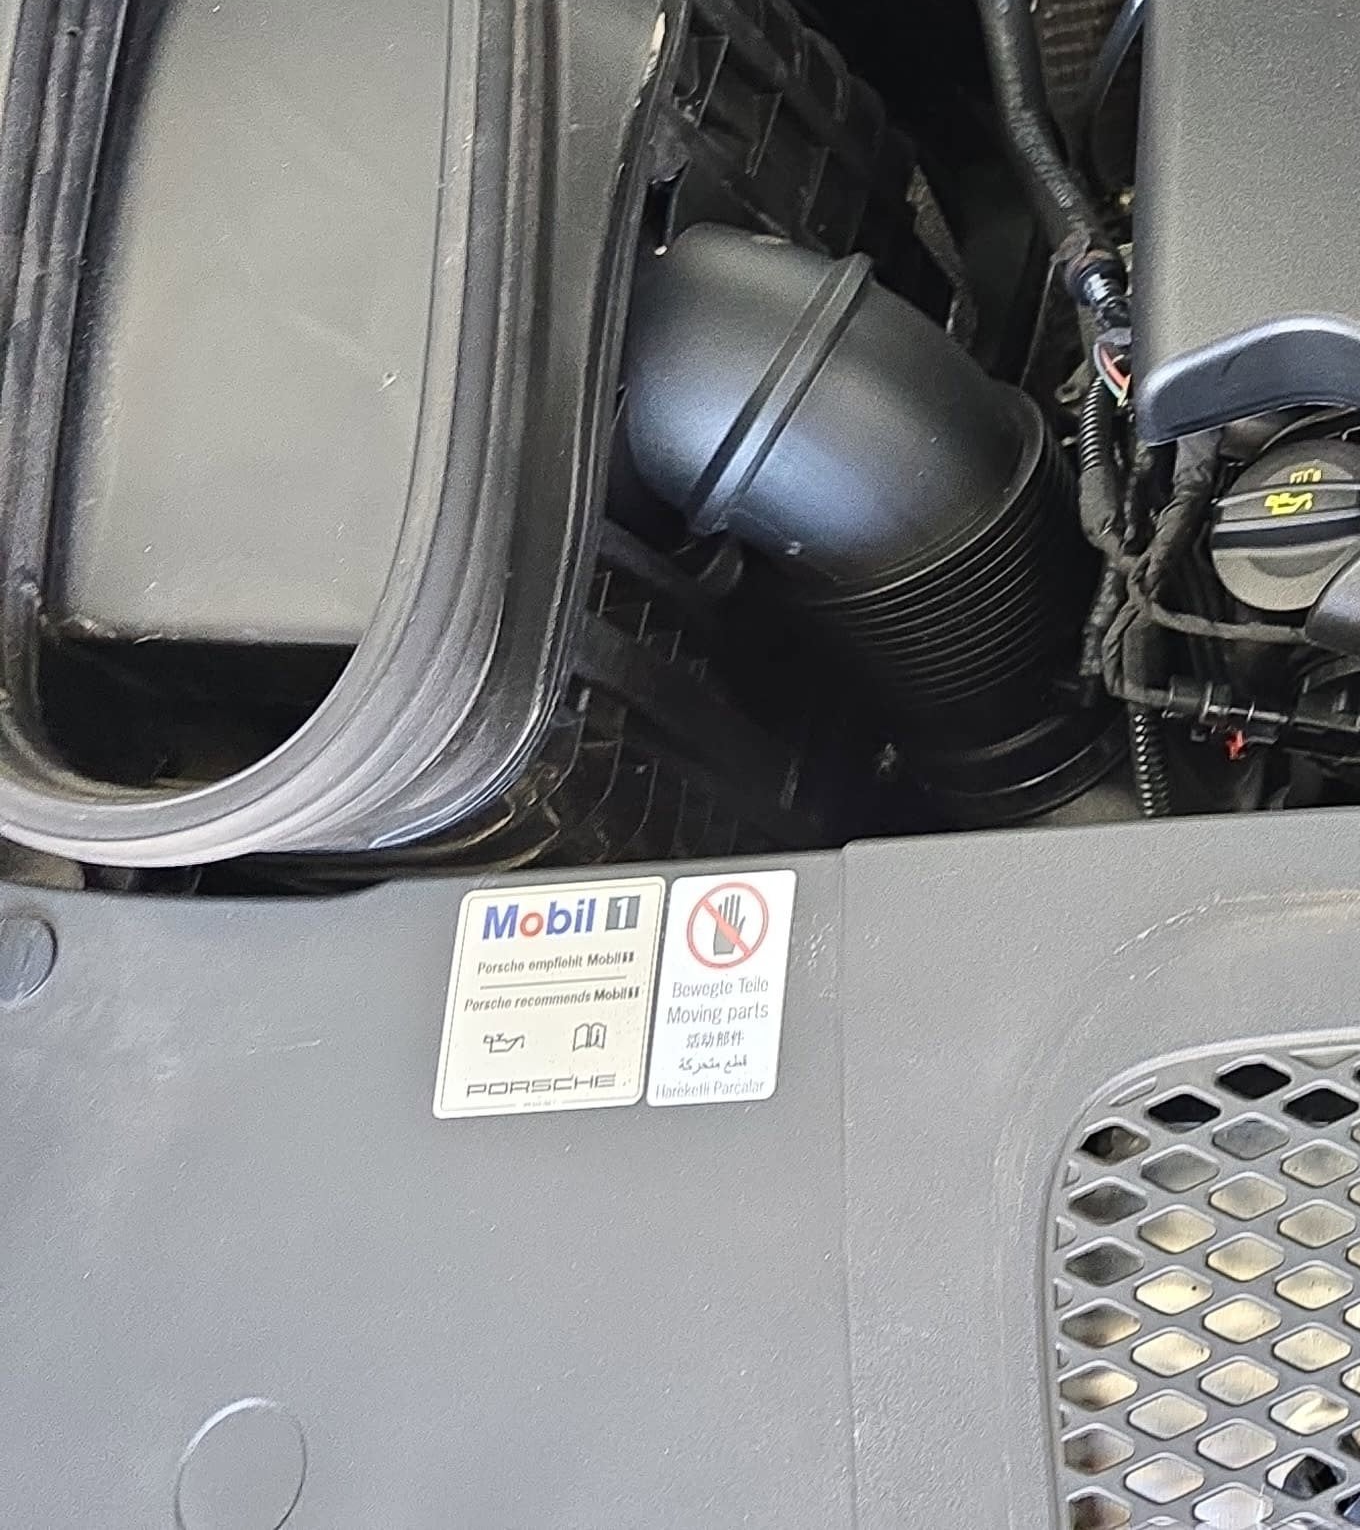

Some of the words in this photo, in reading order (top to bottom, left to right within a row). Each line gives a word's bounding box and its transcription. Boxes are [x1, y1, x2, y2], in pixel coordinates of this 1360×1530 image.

[482, 897, 597, 941] Mobil
[477, 958, 525, 976] Porsche
[529, 954, 583, 973] empfiehlt
[587, 951, 622, 967] Mobil
[464, 996, 512, 1012] Porsche
[514, 989, 592, 1009] recommends
[593, 986, 628, 1003] Mobil
[672, 979, 734, 999] Bewegte
[738, 975, 769, 994] Teile
[666, 1003, 724, 1026] Moving
[727, 1000, 769, 1026] parts
[466, 1073, 617, 1098] PORSCHE
